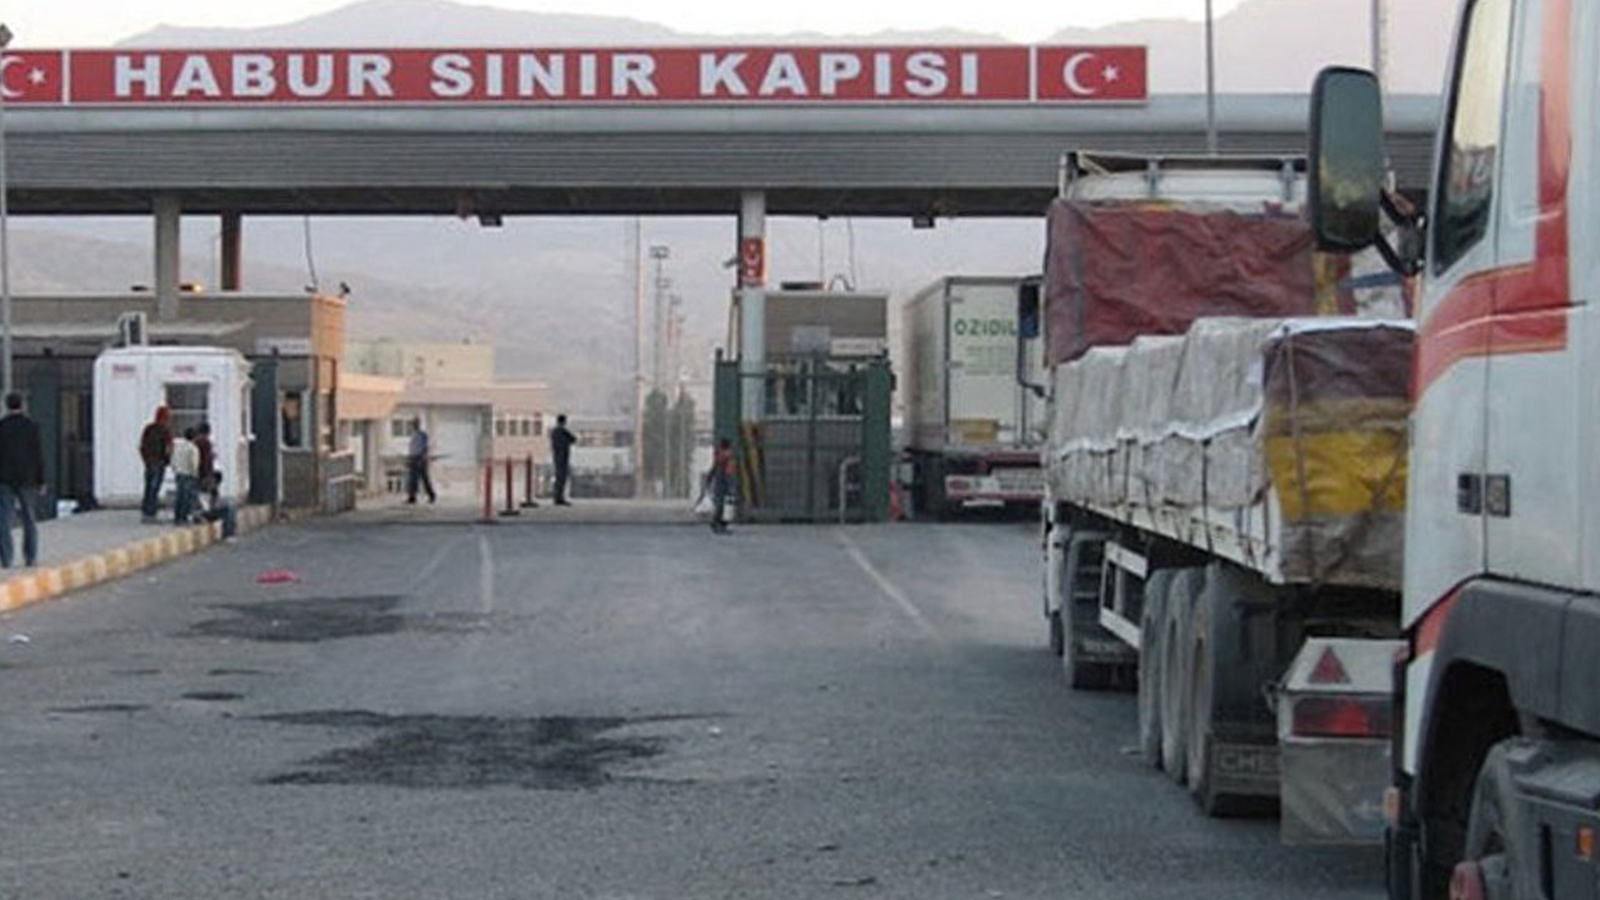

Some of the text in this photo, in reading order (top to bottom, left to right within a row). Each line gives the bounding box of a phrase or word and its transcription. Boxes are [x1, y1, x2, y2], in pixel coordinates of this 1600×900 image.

[114, 52, 979, 97] HABUR SINIR KAPISI
